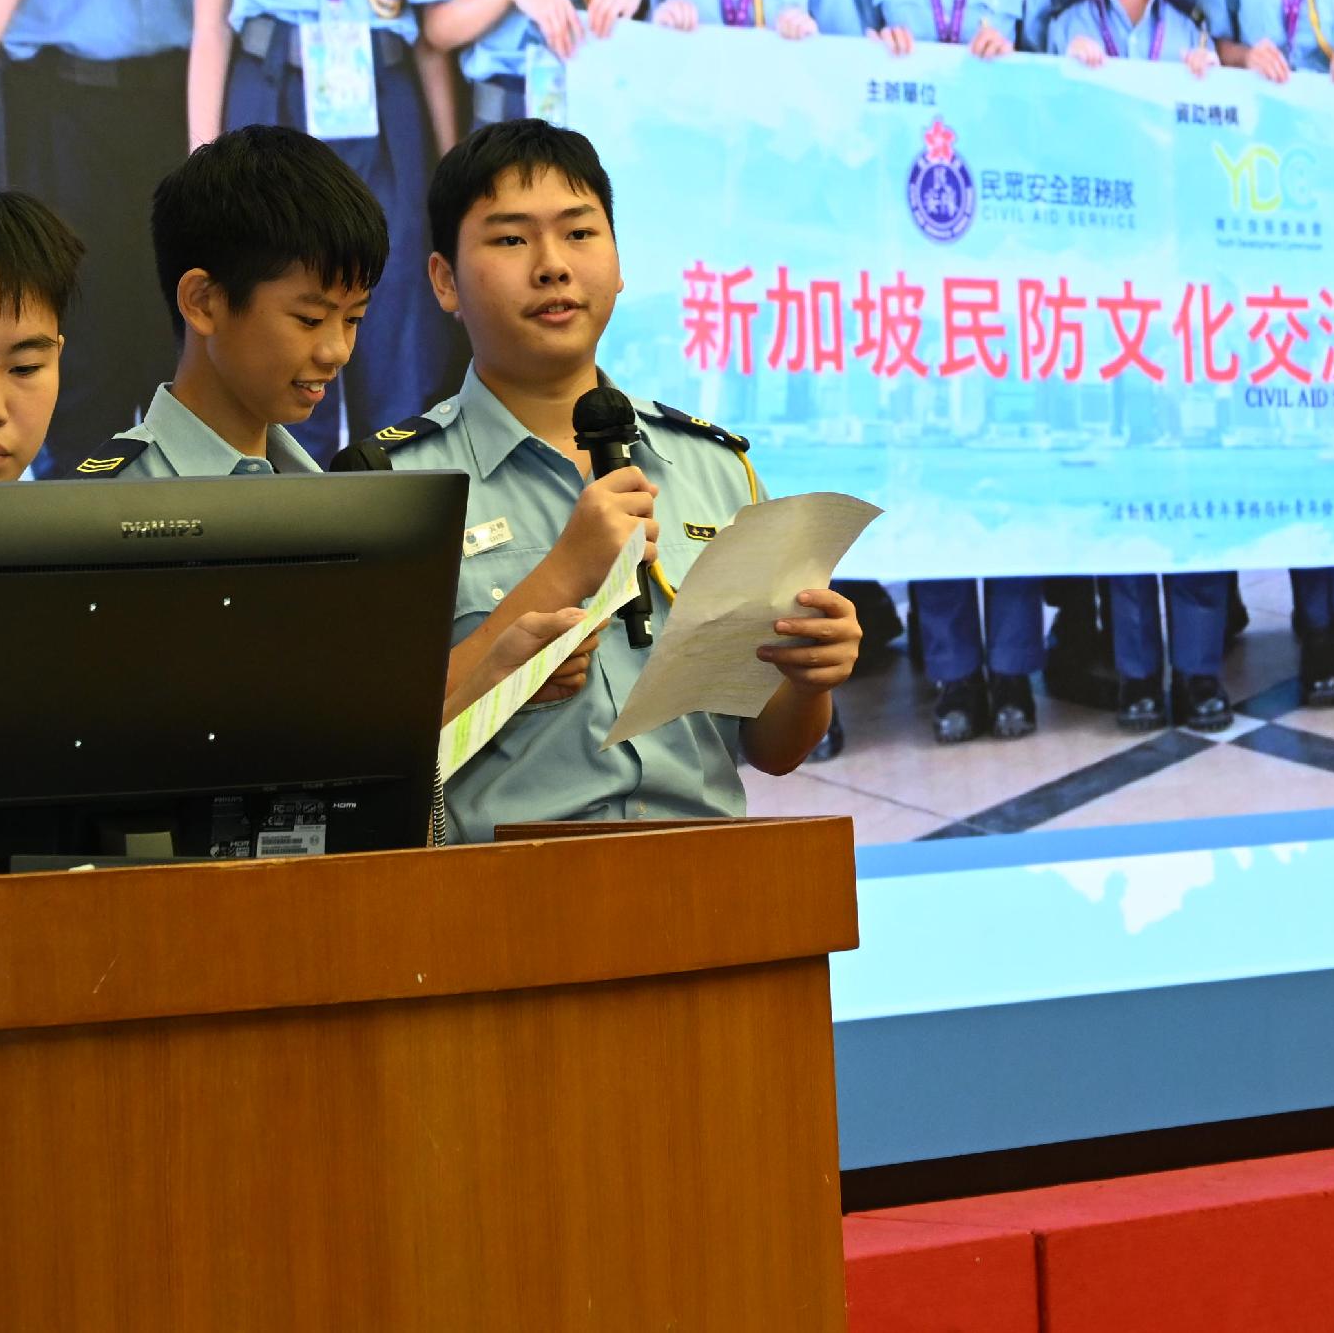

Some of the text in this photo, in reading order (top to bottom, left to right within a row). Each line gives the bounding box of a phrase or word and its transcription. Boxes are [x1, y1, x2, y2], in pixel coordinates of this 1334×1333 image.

[867, 80, 937, 106] 主辦單位
[980, 169, 1137, 210] 民眾安全服務隊
[981, 206, 1137, 229] CIVIL AID SERVICE
[1245, 388, 1290, 408] CIVIL
[1298, 388, 1329, 408] AID
[121, 519, 203, 538] PHILIPS
